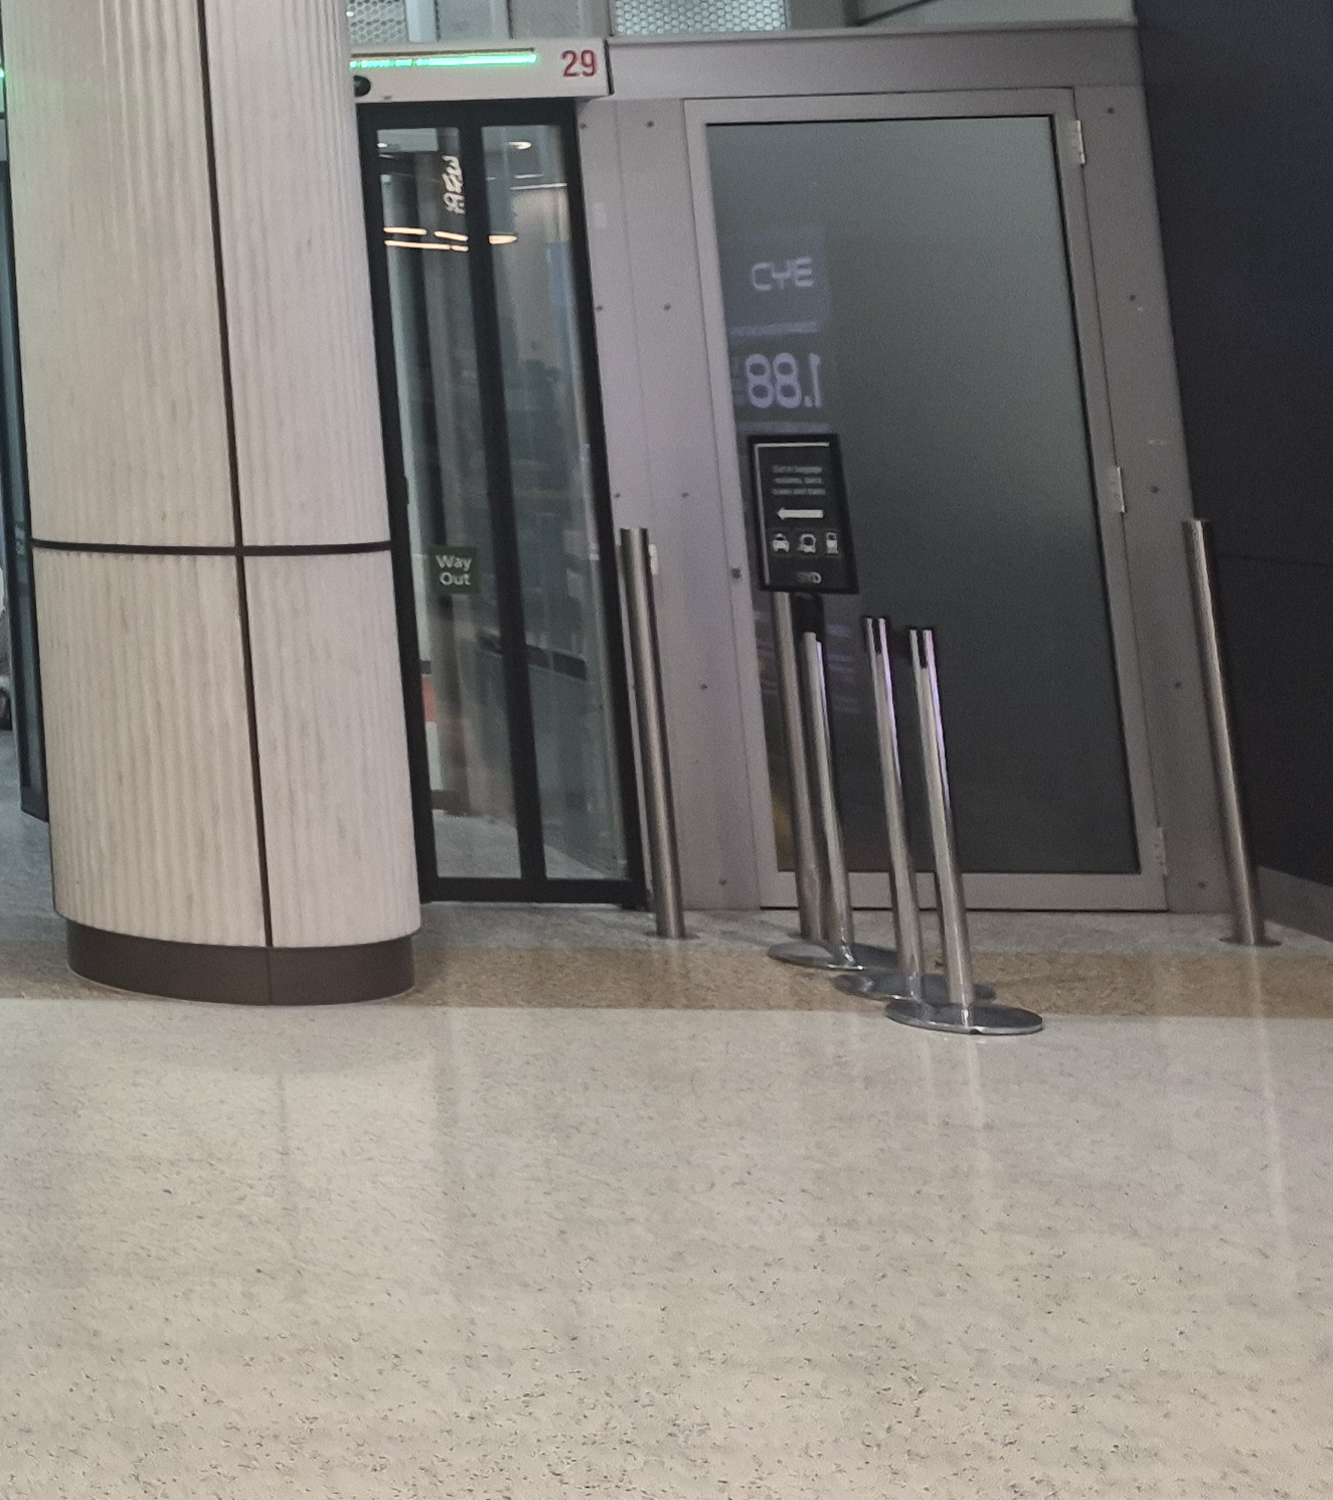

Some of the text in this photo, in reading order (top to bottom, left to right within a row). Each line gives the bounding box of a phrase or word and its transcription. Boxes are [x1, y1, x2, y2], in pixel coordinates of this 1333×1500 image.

[561, 49, 597, 78] 29
[435, 554, 472, 572] Way
[439, 572, 472, 586] Out
